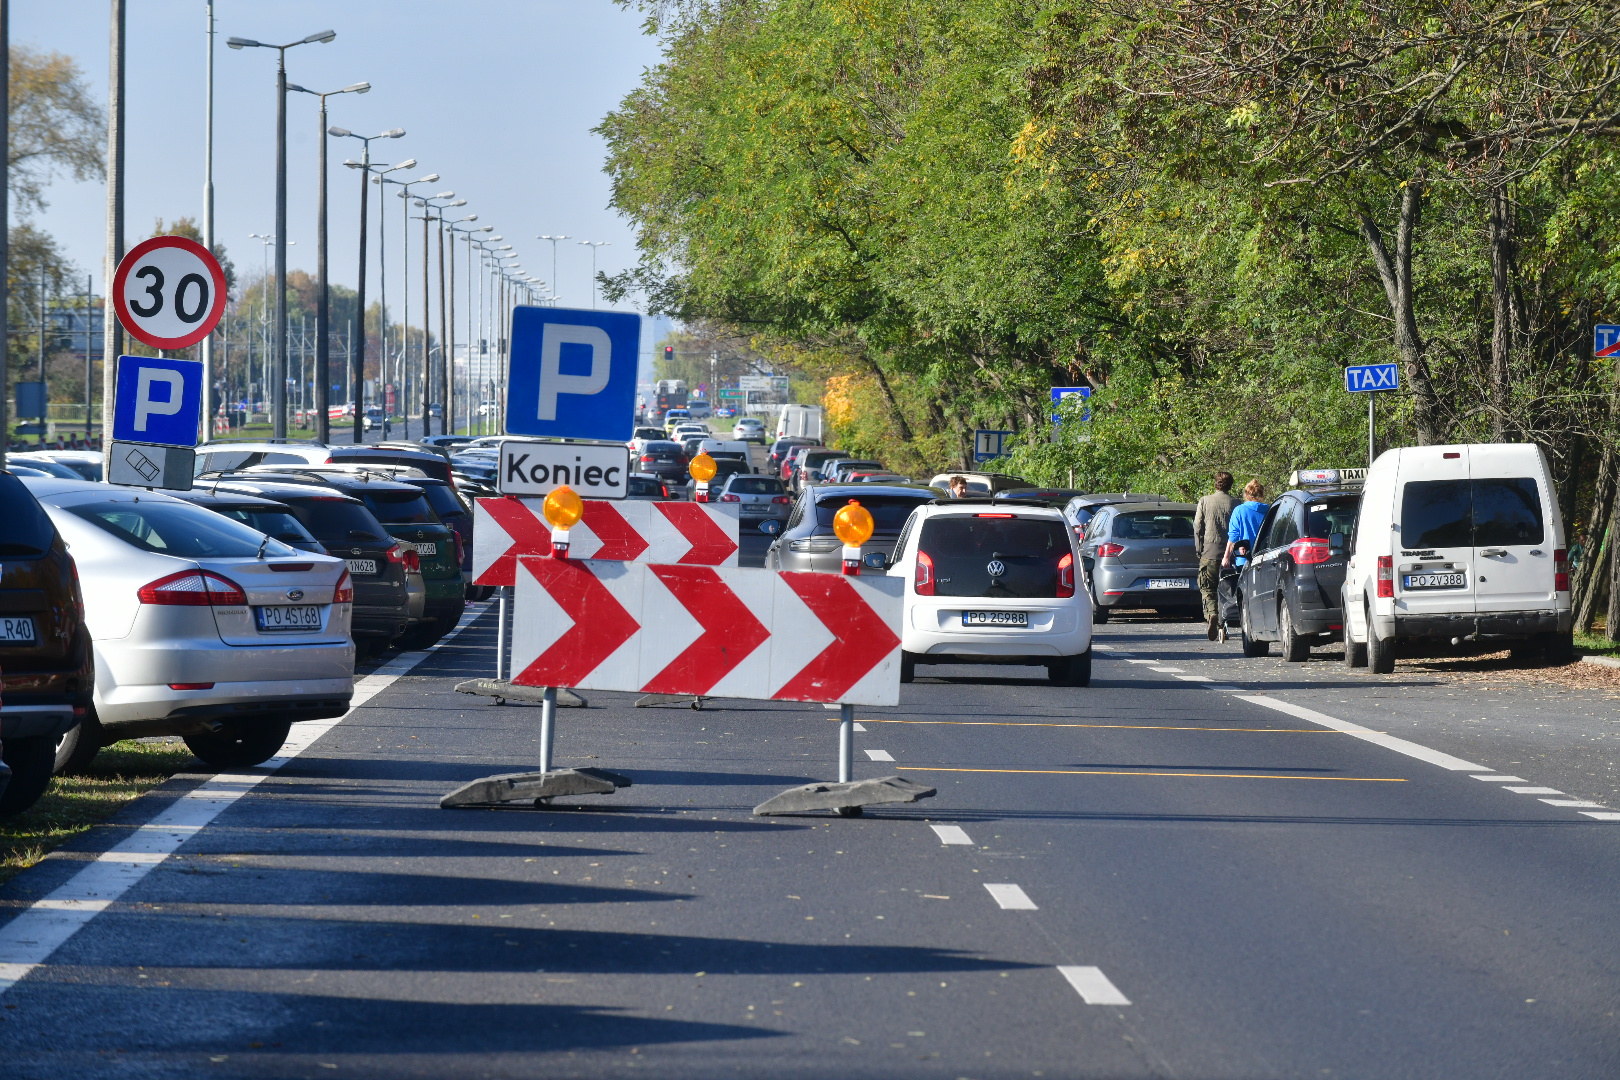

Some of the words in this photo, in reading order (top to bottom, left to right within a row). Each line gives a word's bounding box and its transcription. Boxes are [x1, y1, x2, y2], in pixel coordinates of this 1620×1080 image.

[130, 265, 209, 323] 30
[1598, 329, 1620, 353] T
[537, 322, 612, 421] P
[1349, 367, 1397, 388] TAXI
[134, 367, 185, 431] P
[507, 453, 620, 487] Koniec
[1342, 469, 1364, 480] TAXI
[350, 560, 374, 572] 1N628
[1150, 579, 1162, 588] PZ
[1410, 575, 1426, 586] PO
[1429, 574, 1462, 586] 2V388
[265, 607, 282, 624] PO
[285, 607, 318, 624] 4ST68
[969, 612, 987, 623] PO
[990, 612, 1025, 623] 2G988
